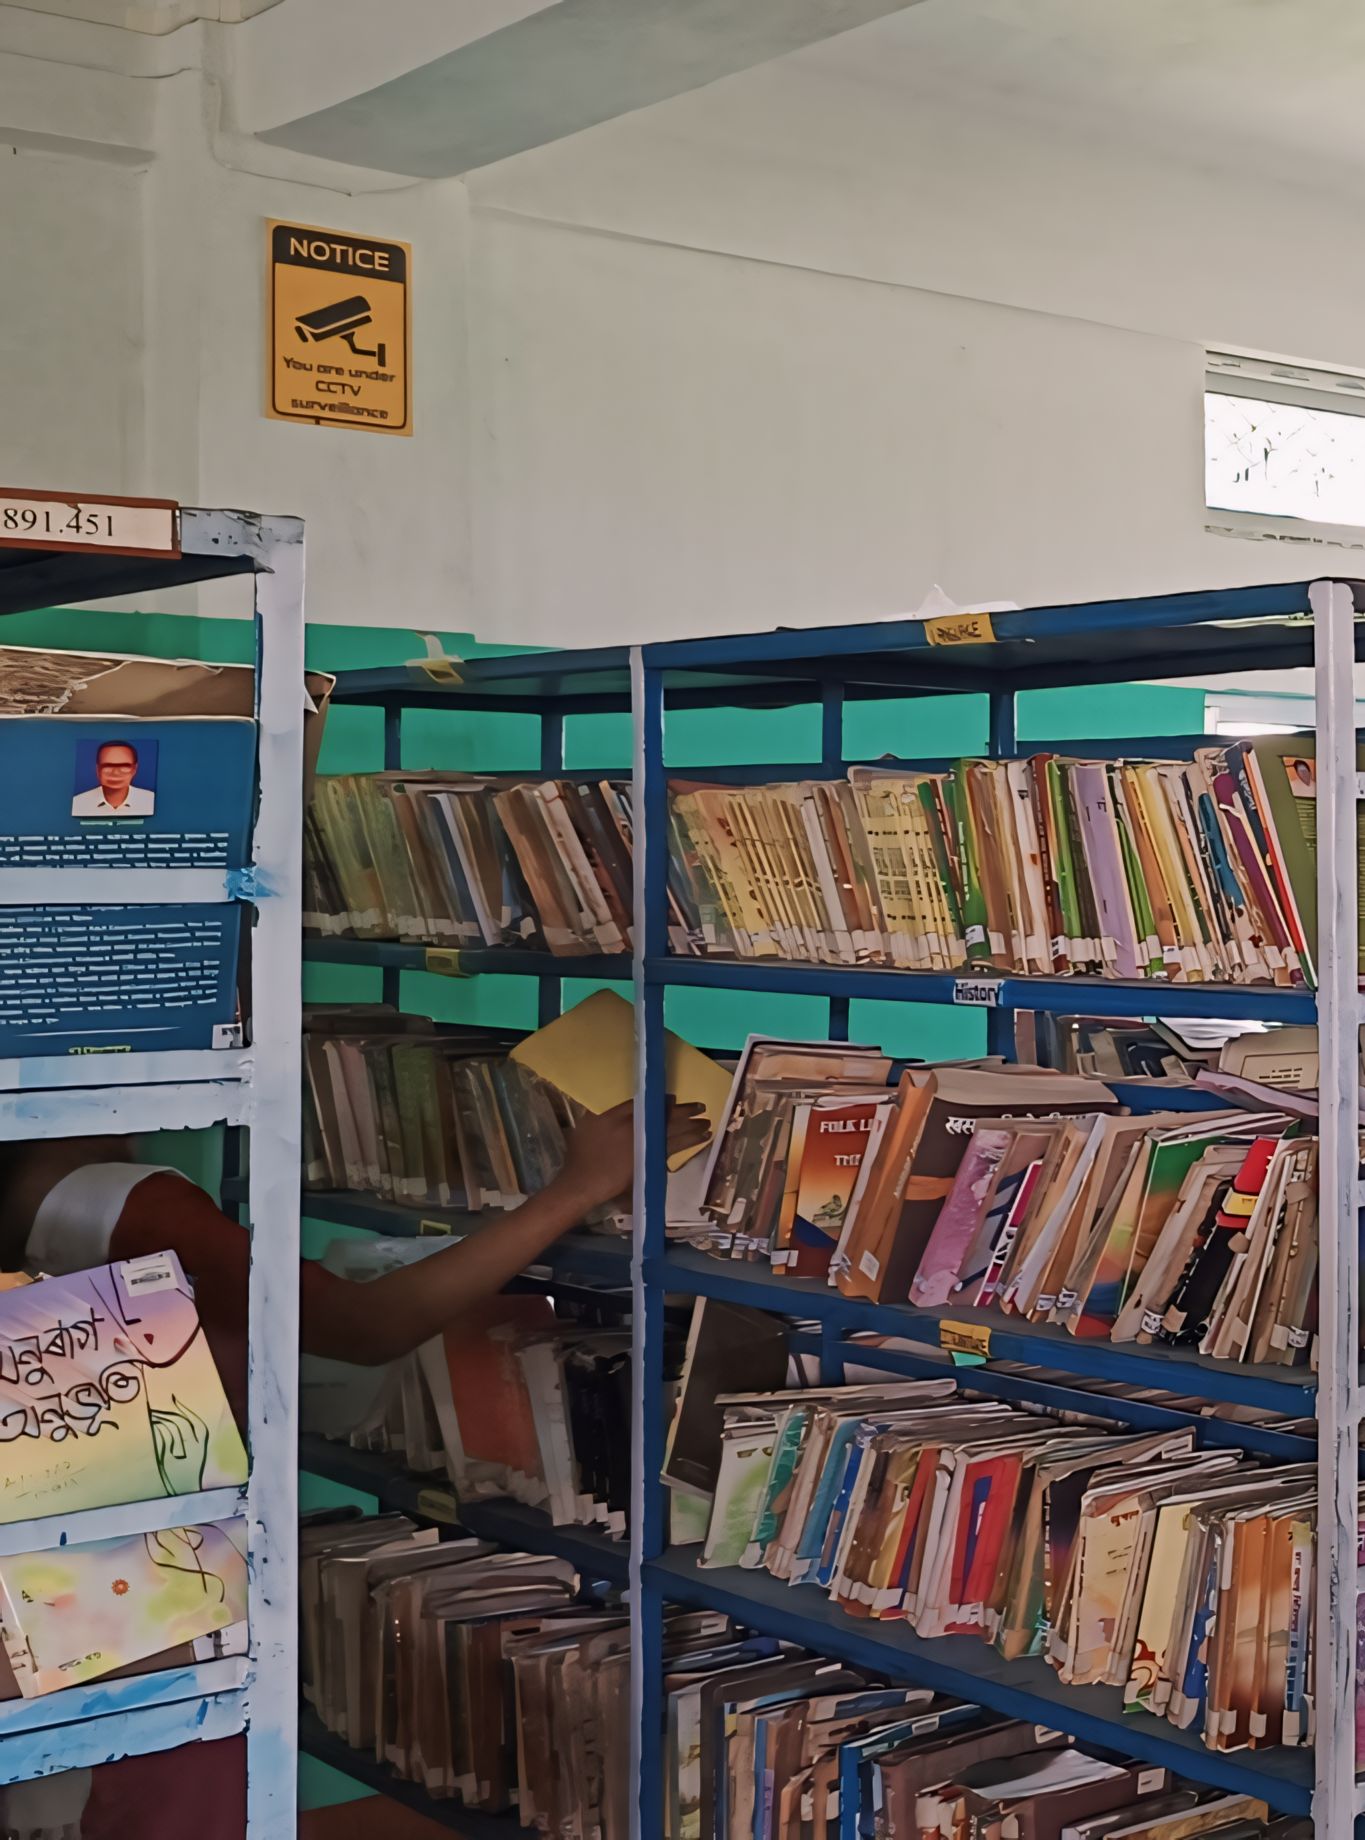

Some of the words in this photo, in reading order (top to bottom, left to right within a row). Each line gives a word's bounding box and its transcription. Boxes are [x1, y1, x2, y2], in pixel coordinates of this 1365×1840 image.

[290, 237, 390, 272] NOTICE
[283, 355, 313, 372] You
[317, 363, 344, 376] are
[348, 367, 396, 382] under
[315, 380, 361, 397] CCTV
[3, 507, 114, 537] 891.451
